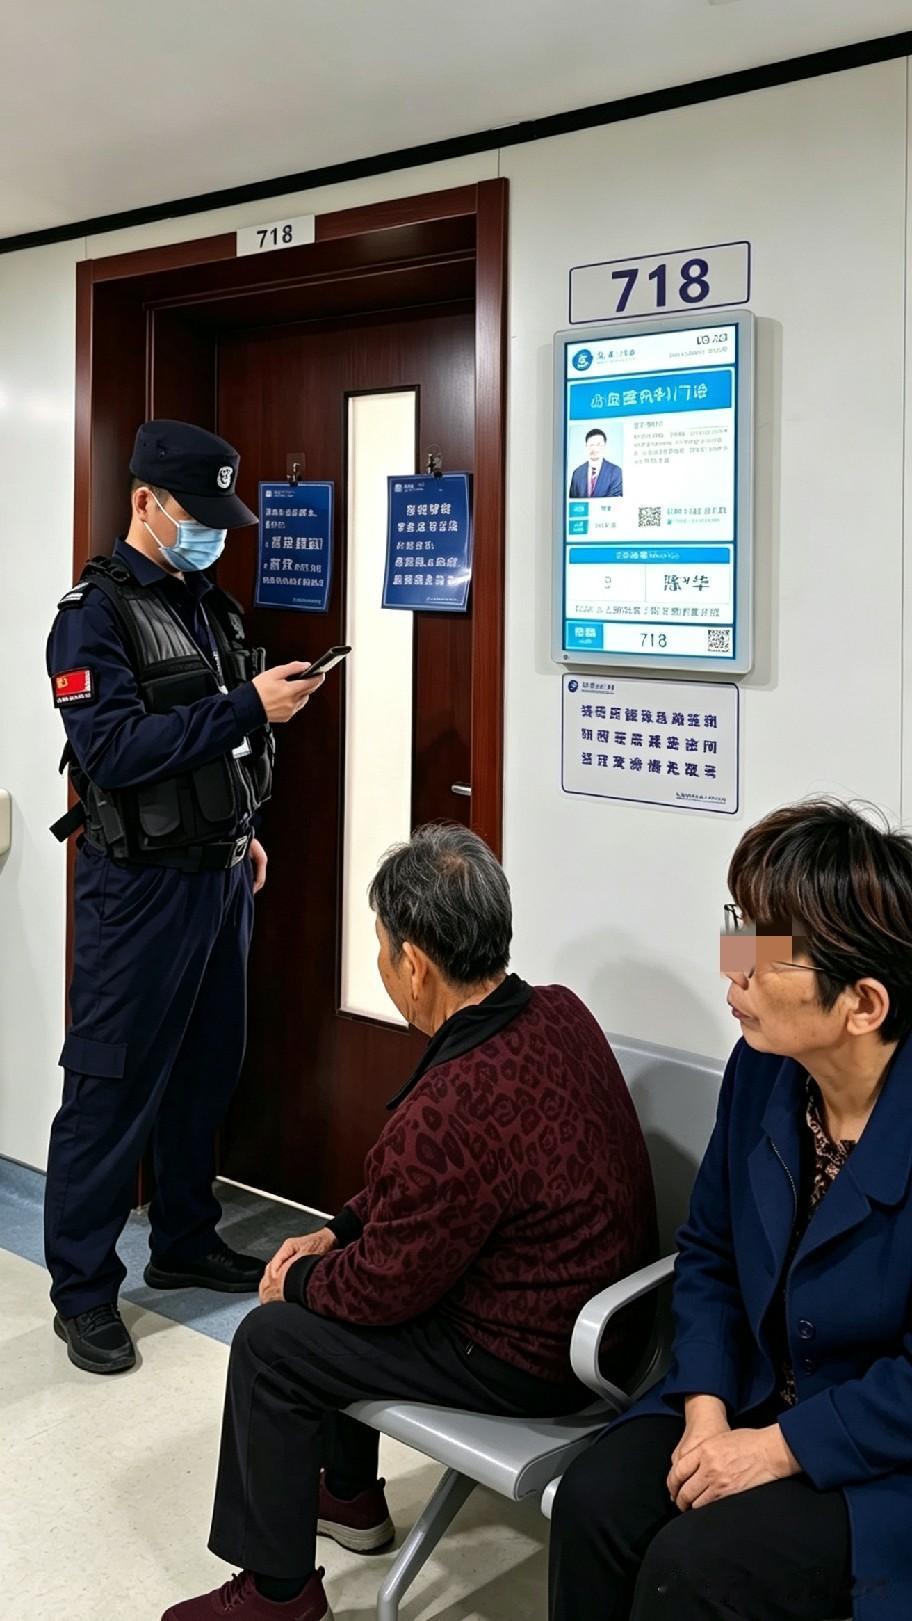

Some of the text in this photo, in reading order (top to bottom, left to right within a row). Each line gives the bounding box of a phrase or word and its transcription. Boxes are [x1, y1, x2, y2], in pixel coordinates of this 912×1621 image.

[257, 225, 292, 248] 718
[612, 258, 710, 312] 718
[641, 633, 667, 648] 718
